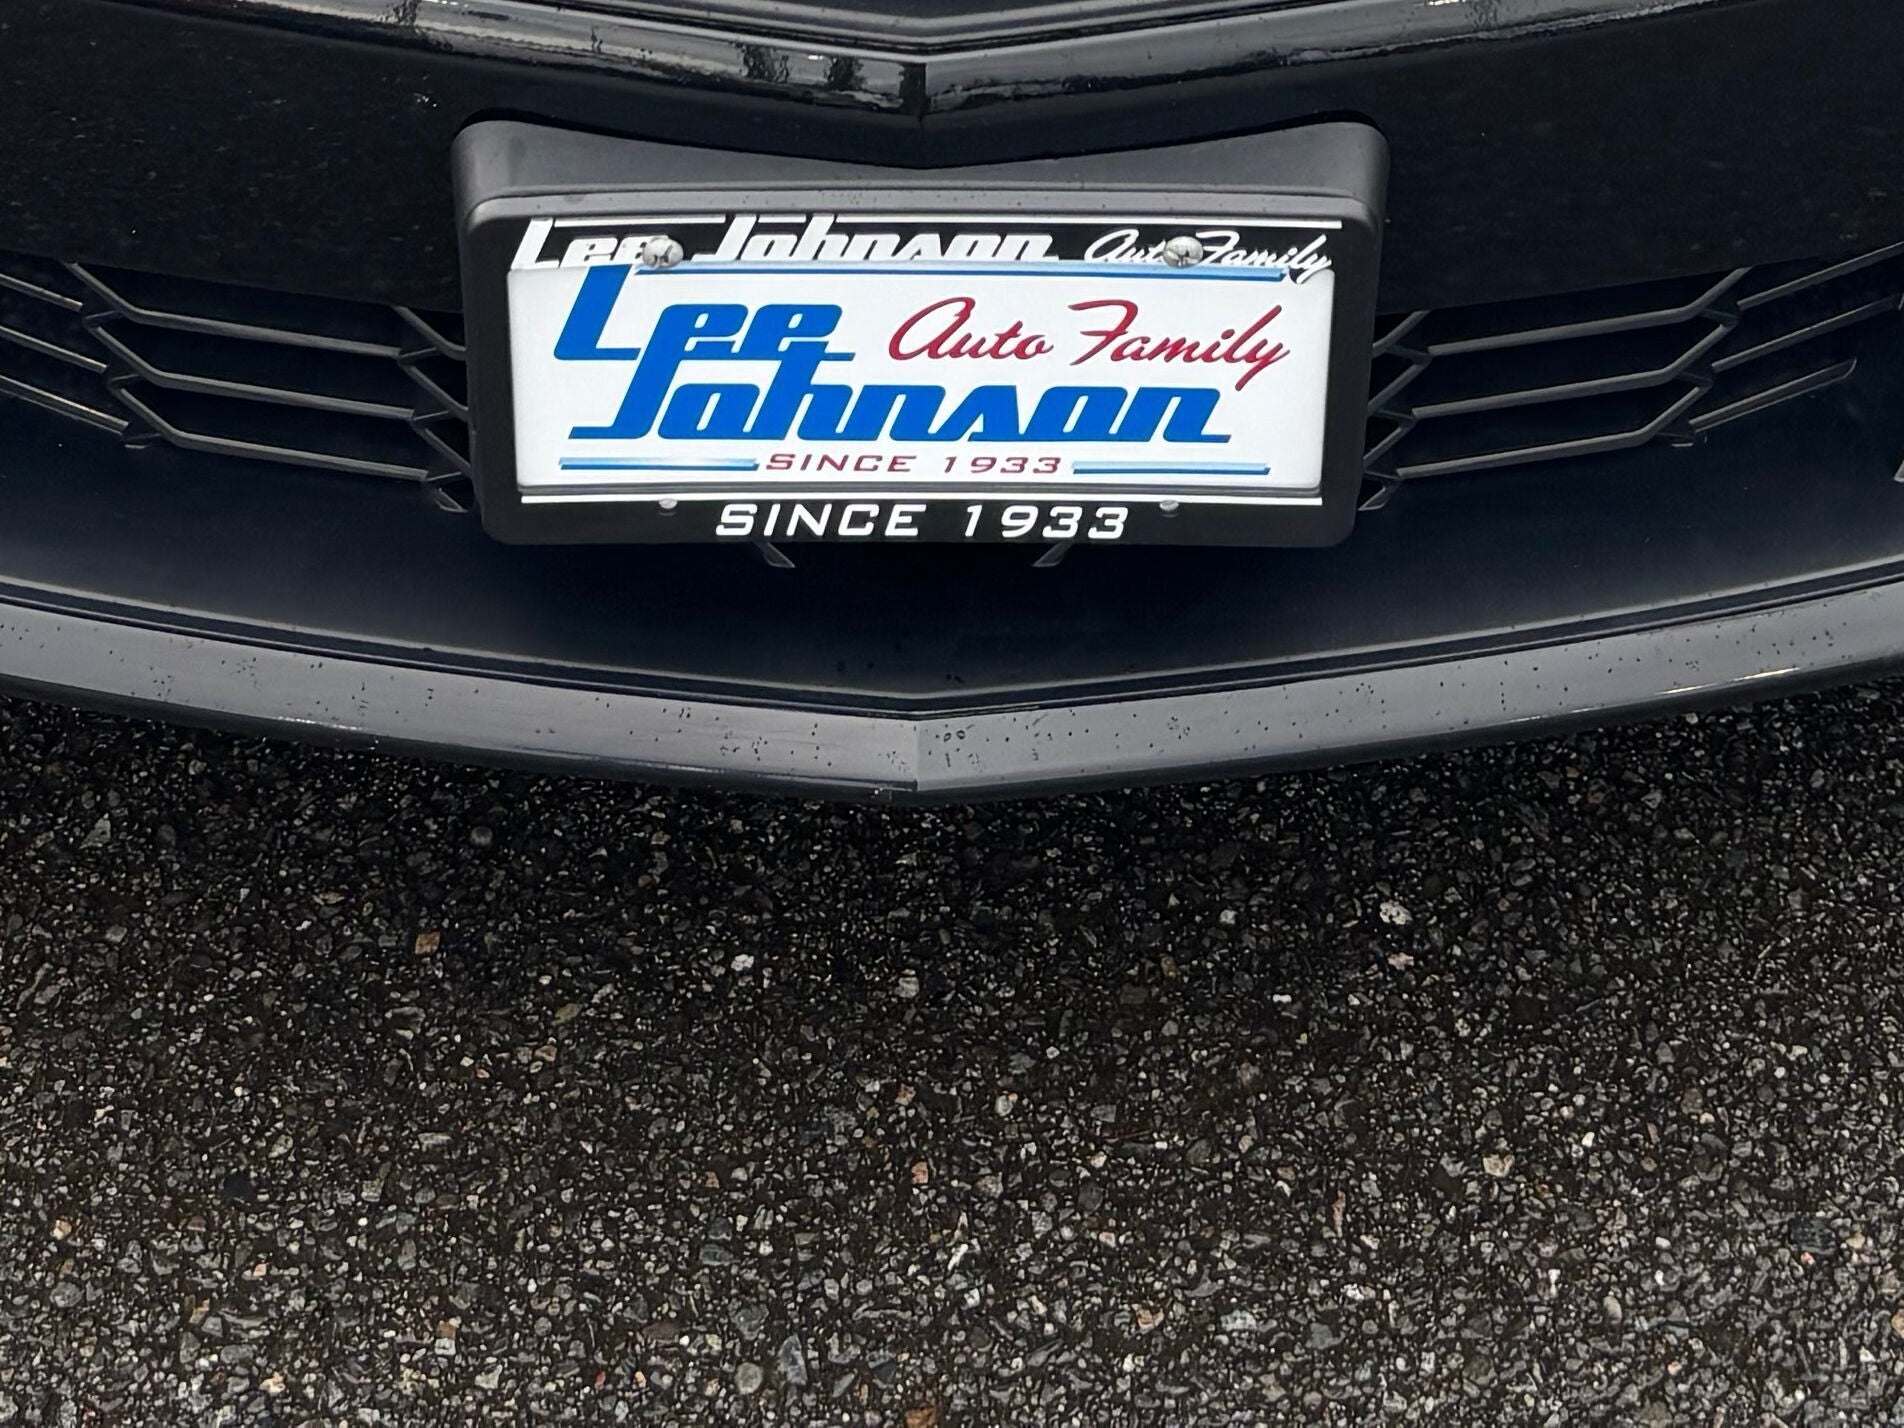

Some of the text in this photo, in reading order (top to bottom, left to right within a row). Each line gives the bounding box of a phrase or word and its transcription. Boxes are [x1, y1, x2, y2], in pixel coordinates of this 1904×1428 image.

[690, 211, 1060, 262] Johnson
[1194, 229, 1333, 284] Family
[553, 263, 856, 361] Lee
[888, 296, 1291, 392] Auto Family
[568, 341, 1232, 443] Johnson
[765, 453, 1062, 475] SINCE 1933
[714, 503, 1129, 540] SINCE 1933
